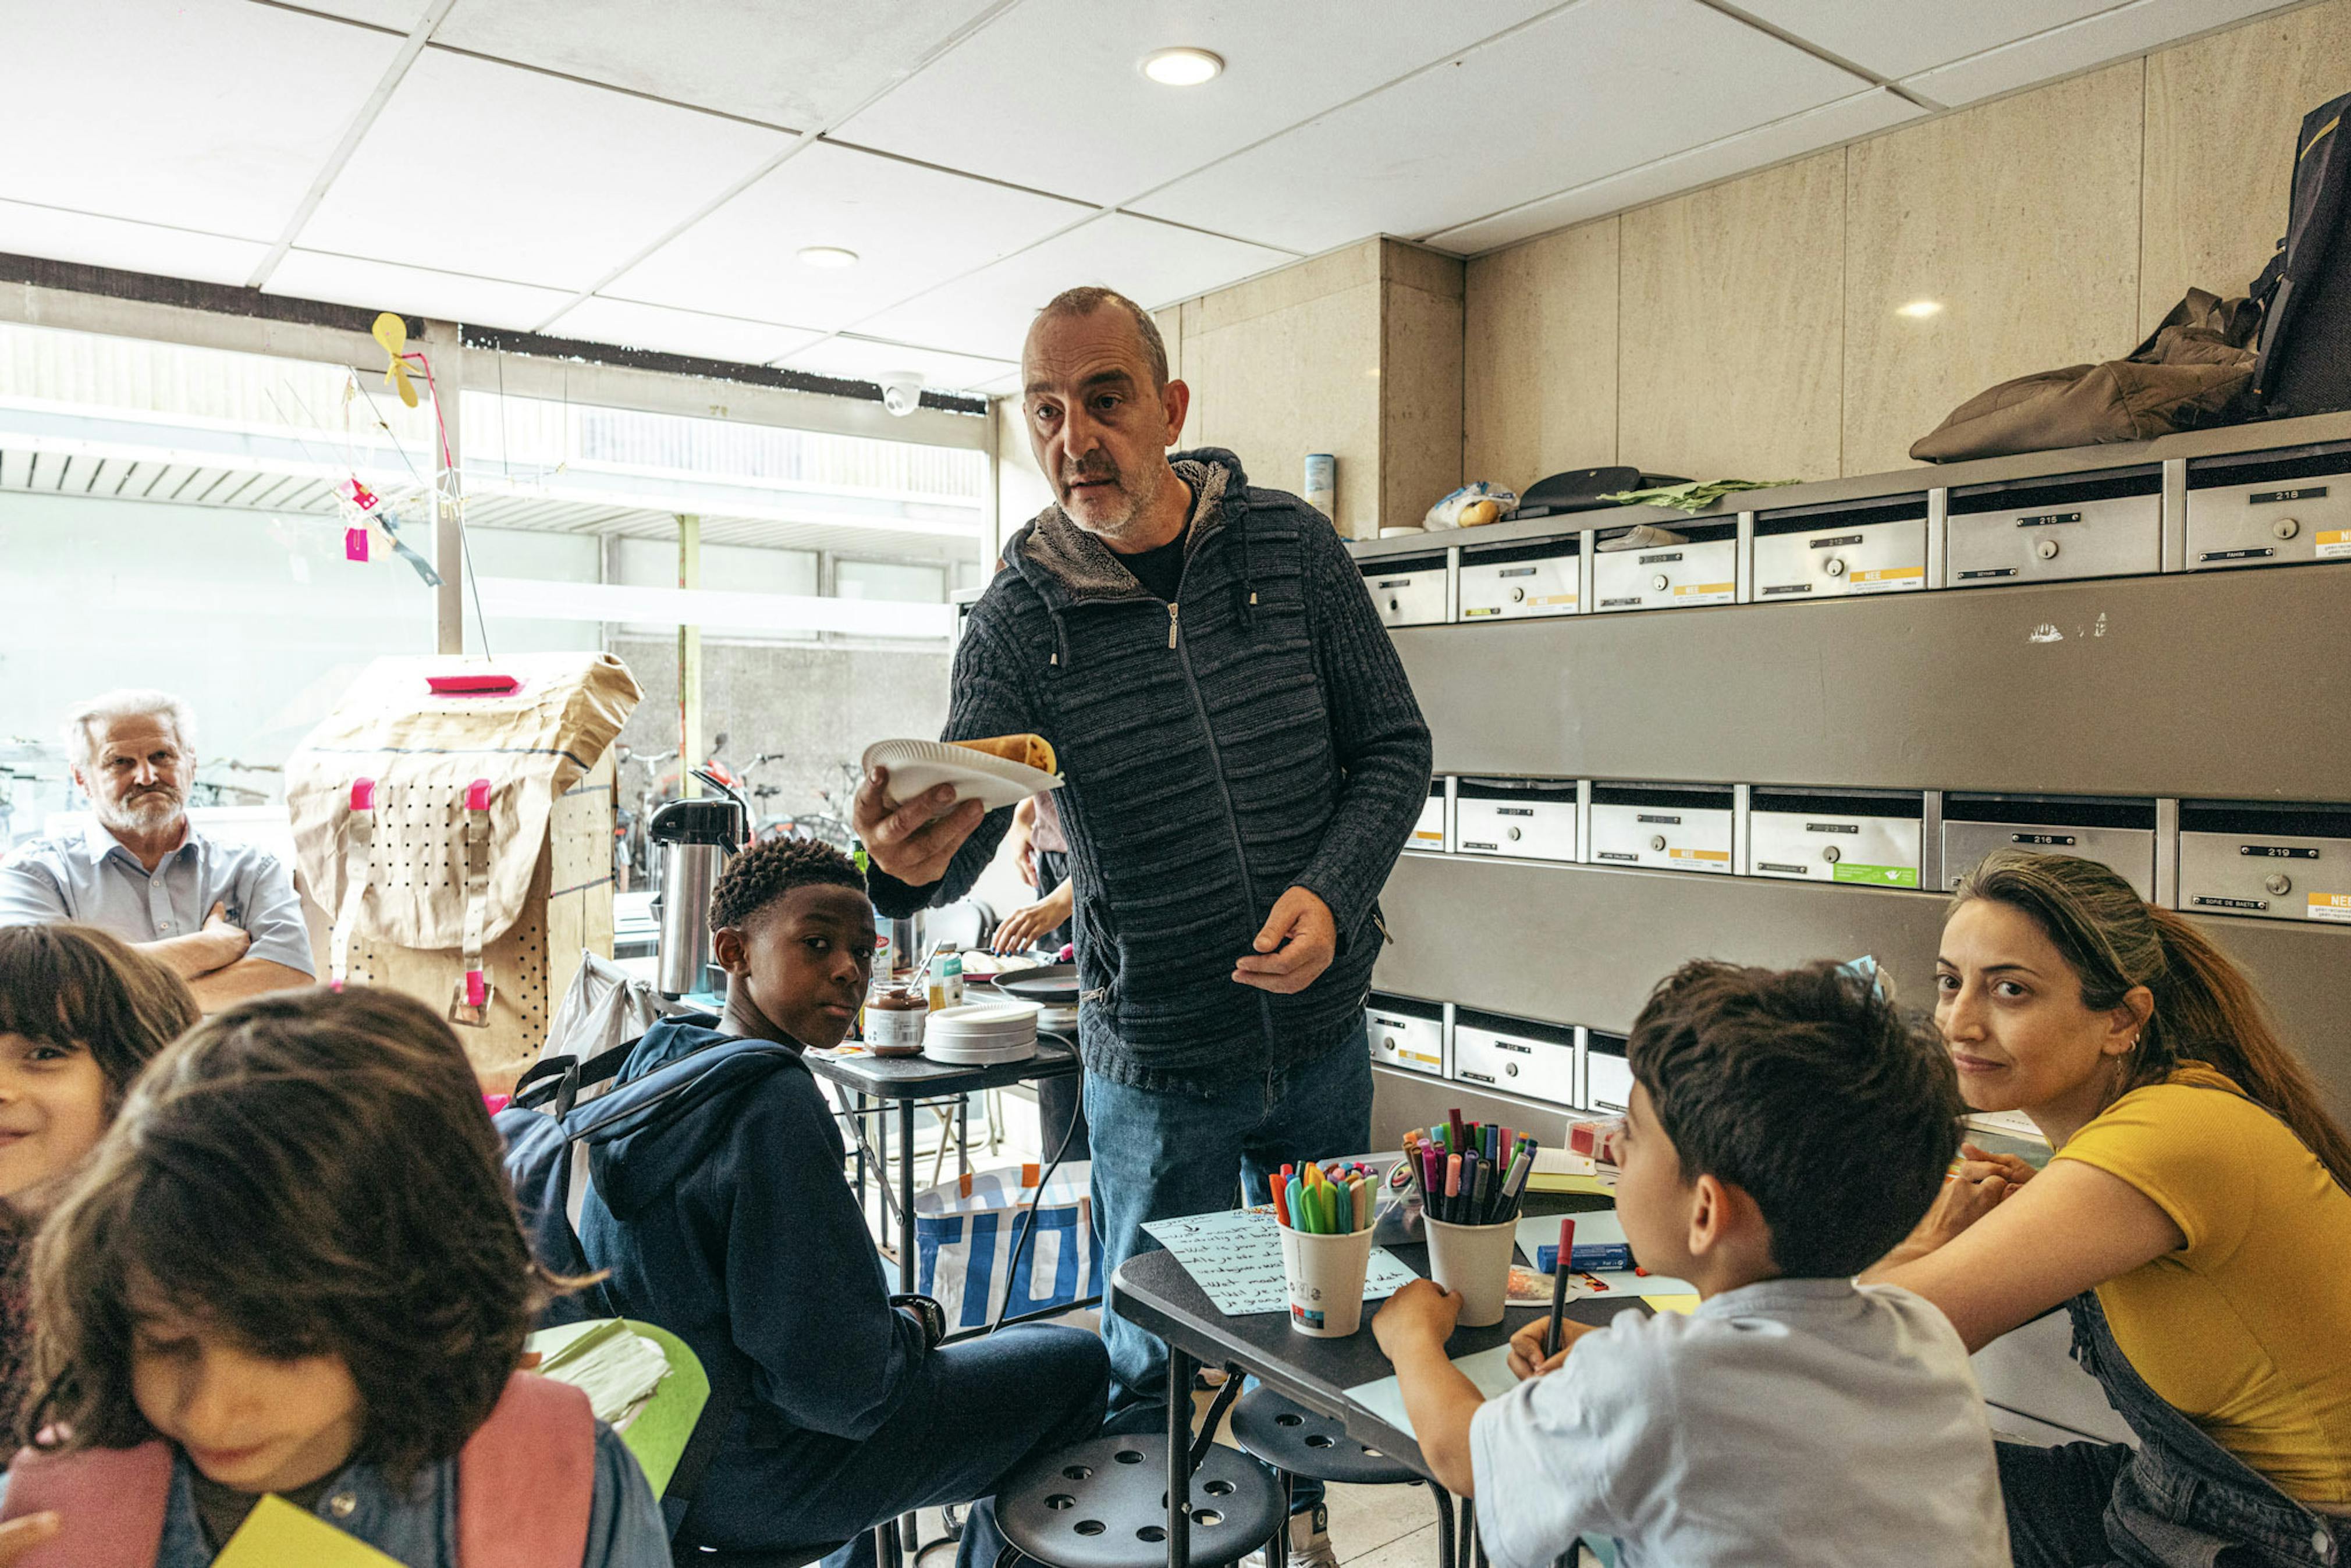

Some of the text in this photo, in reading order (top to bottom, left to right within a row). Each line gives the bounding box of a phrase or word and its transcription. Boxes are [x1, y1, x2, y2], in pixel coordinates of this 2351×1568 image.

[2276, 491, 2298, 500] 218
[2039, 516, 2057, 524] 215
[2341, 531, 2351, 542] N
[1865, 571, 1881, 581] NEE
[2034, 835, 2052, 844] 216
[2268, 848, 2290, 857] 219
[1207, 1278, 1240, 1287] Wat
